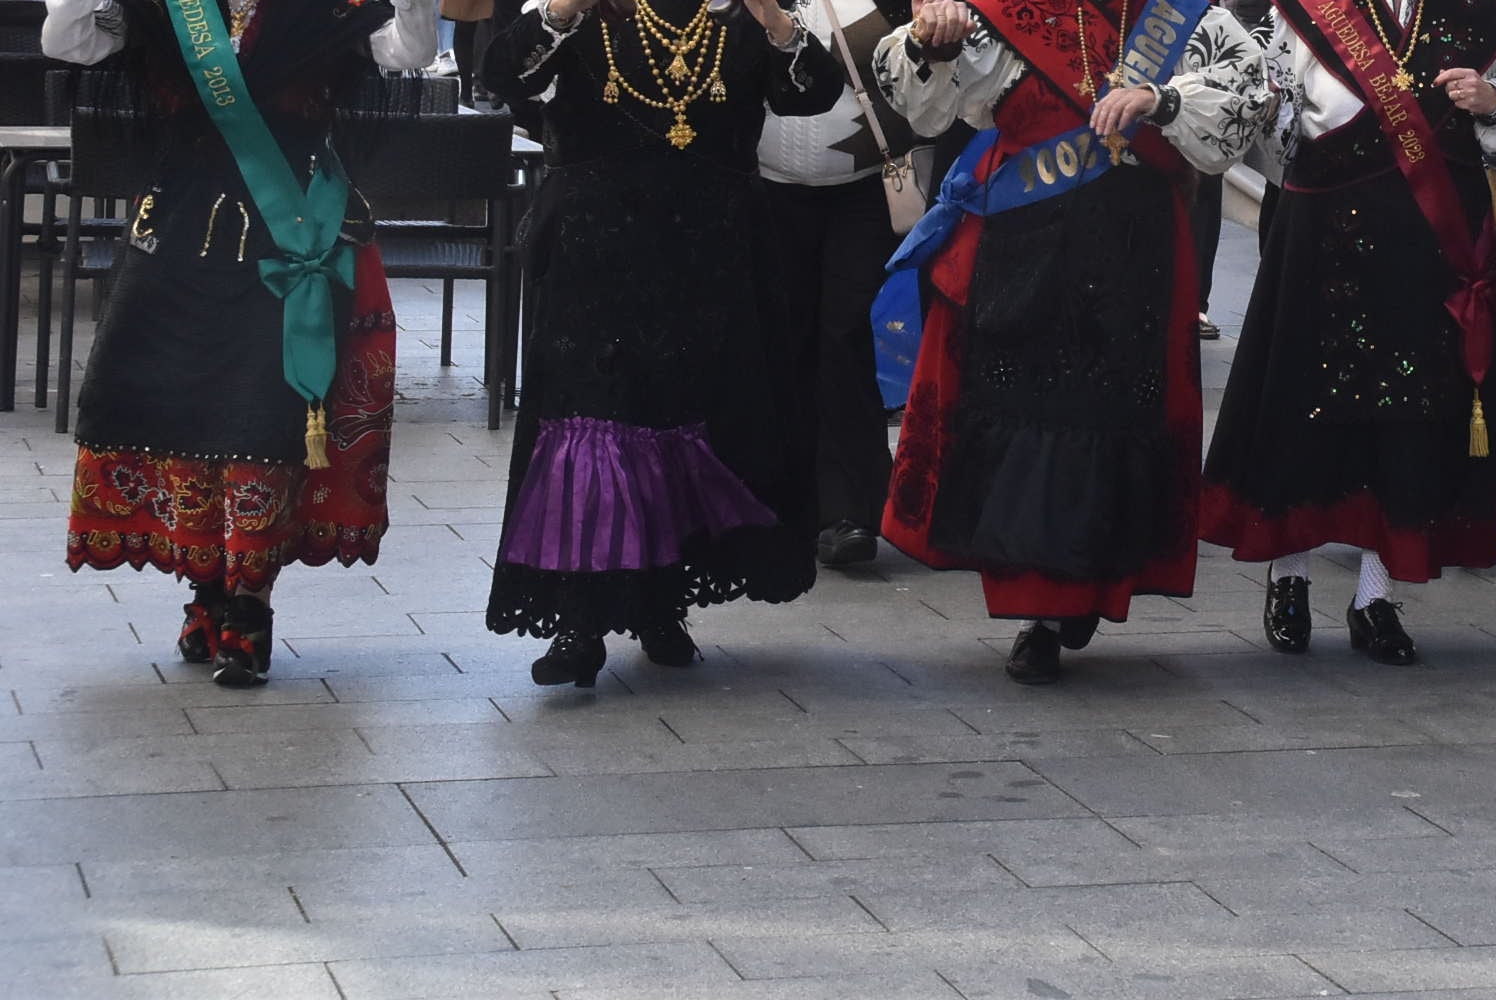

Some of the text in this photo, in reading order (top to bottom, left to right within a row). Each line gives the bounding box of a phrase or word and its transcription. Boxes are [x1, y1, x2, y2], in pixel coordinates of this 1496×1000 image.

[202, 64, 236, 108] 2013
[1369, 73, 1409, 127] BEJAR
[1397, 129, 1426, 164] 2023
